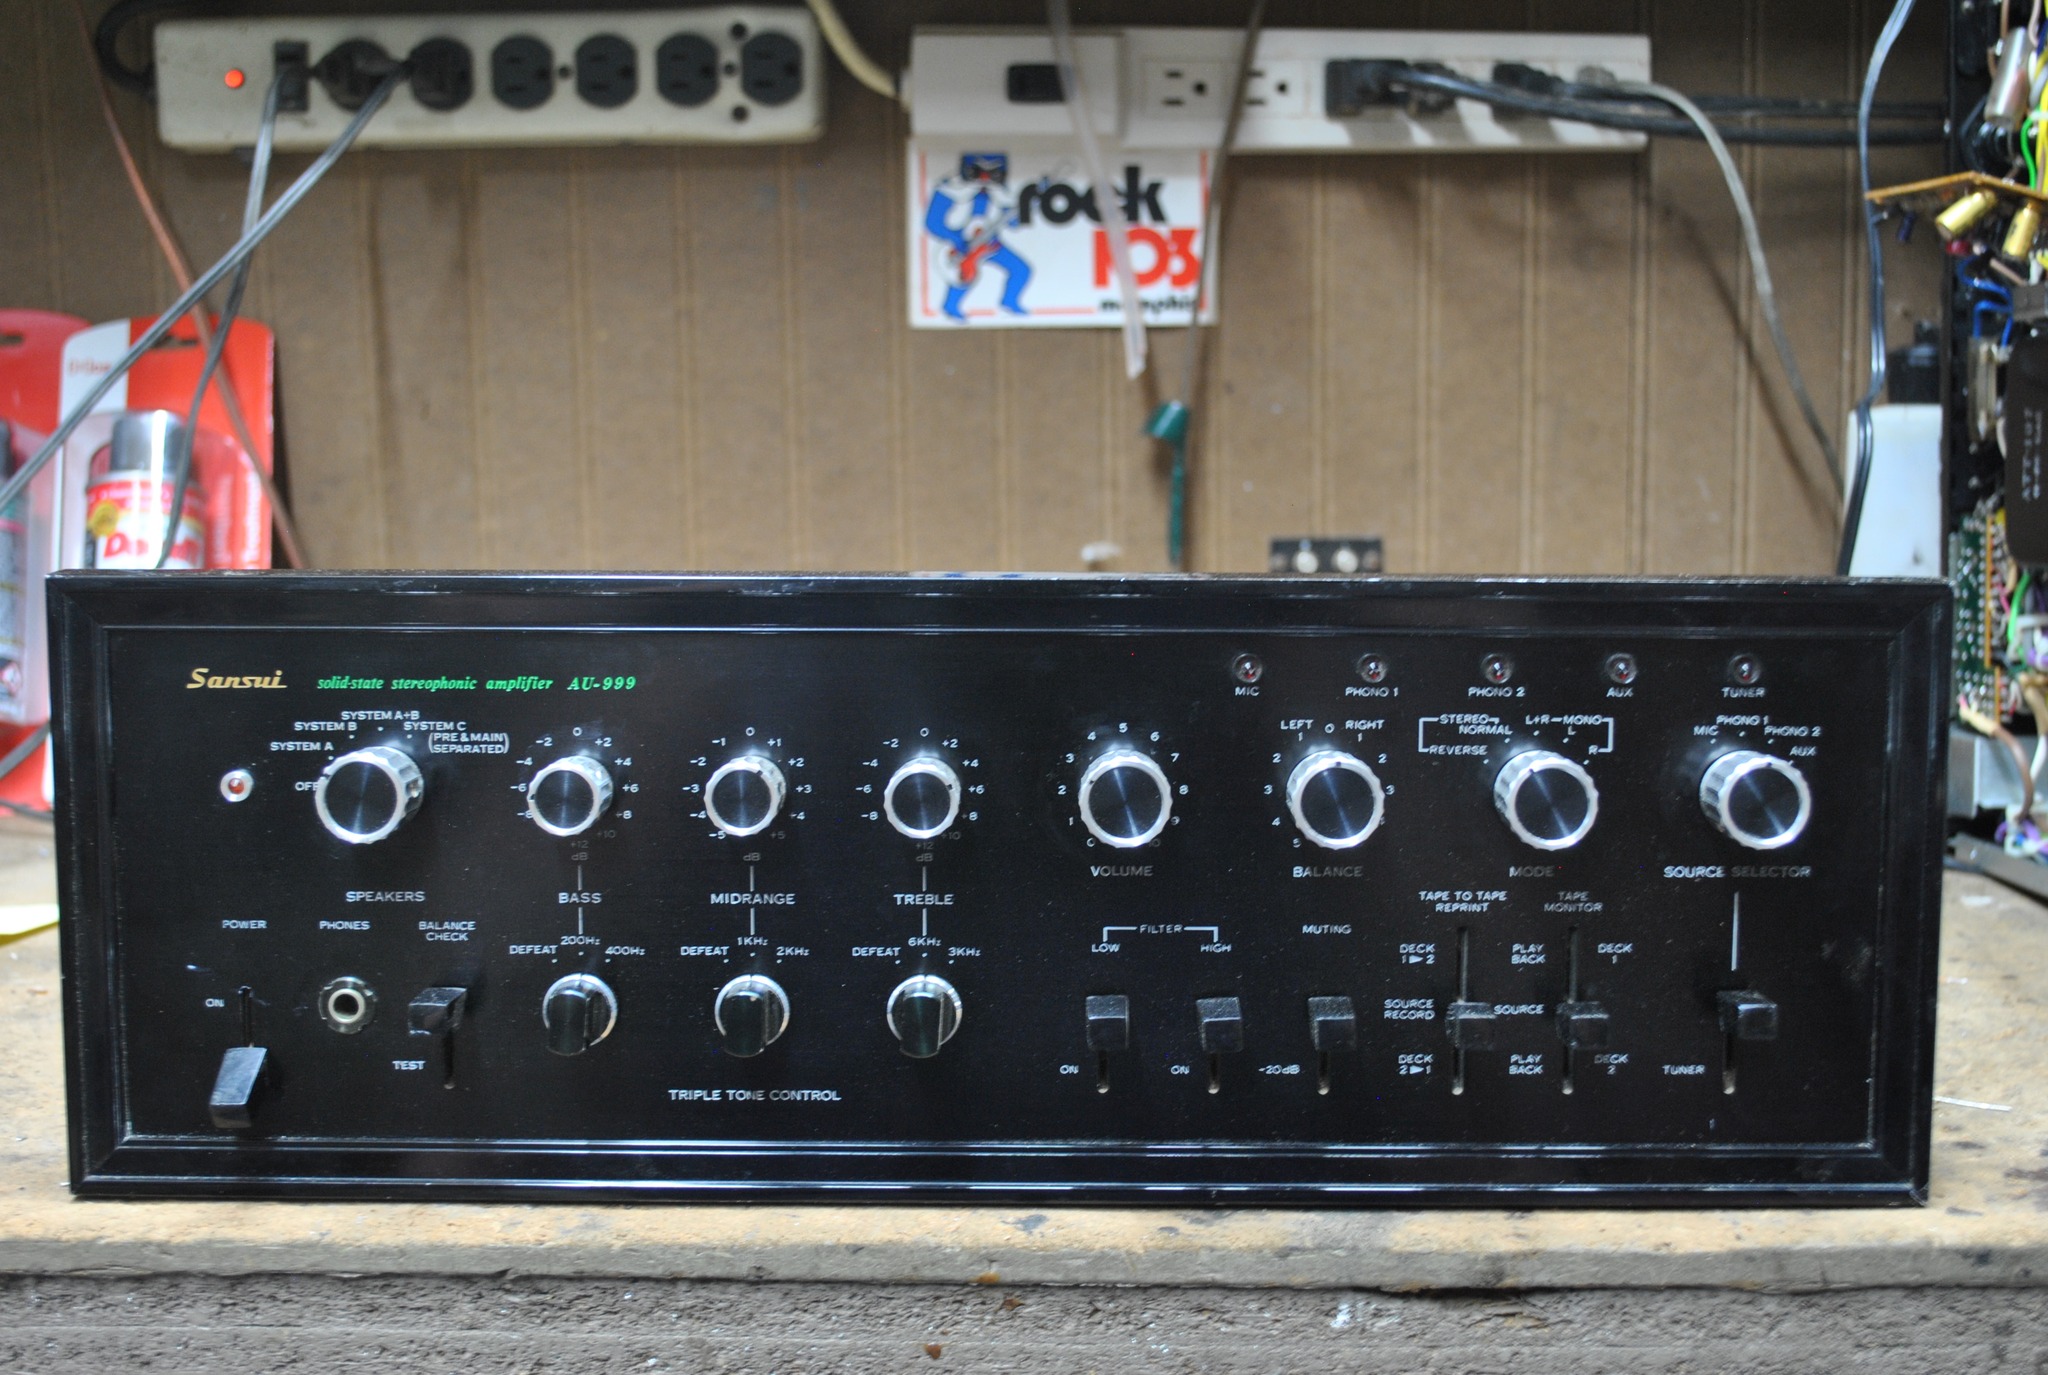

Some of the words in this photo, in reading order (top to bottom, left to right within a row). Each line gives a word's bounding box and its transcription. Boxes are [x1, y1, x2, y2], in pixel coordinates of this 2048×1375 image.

[186, 667, 287, 689] Sansui
[317, 677, 384, 690] solid-state
[390, 677, 477, 692] stereophonic
[485, 676, 553, 692] amplifier
[567, 677, 636, 691] AU-999
[1235, 687, 1260, 697] MIC
[1345, 687, 1389, 697] PHONO
[1393, 687, 1399, 697] 1
[1468, 687, 1512, 697] PHONO
[1516, 687, 1526, 697] 2
[1606, 687, 1633, 698] AUX
[1721, 687, 1765, 698] TUNER
[341, 711, 392, 720] SYSTEM
[393, 711, 420, 720] A+B
[1439, 714, 1489, 724] STEREO
[1563, 714, 1601, 725] MONO
[1716, 715, 1760, 725] PHONO
[1763, 715, 1769, 725] 1
[294, 722, 346, 731] SYSTEM
[349, 722, 358, 731] B
[403, 722, 453, 731] SYSTEM
[456, 722, 466, 731] C
[1118, 723, 1128, 733] 5
[1280, 720, 1314, 730] LEFT
[1345, 720, 1385, 730] RIGHT
[1458, 725, 1513, 735] NORMAL
[1567, 726, 1576, 735] L
[1693, 725, 1719, 736] MIC
[1764, 726, 1808, 736] PHONO
[1811, 726, 1821, 737] 2
[535, 737, 553, 746] -2
[1087, 732, 1097, 741] 4
[1150, 732, 1160, 742] 6
[1298, 732, 1303, 741] 1
[1357, 733, 1363, 742] 1
[270, 742, 321, 751] SYSTEM
[324, 742, 334, 751] A
[595, 737, 612, 747] +2
[712, 738, 726, 746] -1
[767, 738, 782, 747] +1
[883, 739, 899, 748] -2
[942, 739, 958, 748] +2
[1429, 745, 1488, 755] REVERSE
[1589, 746, 1598, 755] R
[1789, 746, 1816, 757] AUX
[516, 757, 533, 766] -4
[615, 757, 632, 766] +4
[690, 757, 707, 766] -2
[788, 757, 805, 767] +2
[1065, 753, 1075, 763] 3
[1171, 753, 1180, 762] 7
[1272, 753, 1282, 763] 2
[1378, 754, 1387, 763] 2
[862, 759, 878, 768] -4
[962, 759, 979, 768] +4
[510, 783, 528, 792] -6
[622, 784, 639, 793] +6
[682, 784, 700, 793] -3
[796, 784, 813, 794] +3
[855, 785, 872, 794] -6
[968, 785, 985, 794] +6
[1057, 785, 1067, 795] 2
[1179, 785, 1189, 795] 8
[1264, 785, 1273, 795] 3
[1385, 785, 1395, 795] 3
[615, 810, 632, 819] +8
[689, 811, 707, 819] -4
[789, 811, 806, 820] +4
[861, 811, 878, 820] -8
[1069, 817, 1074, 826] 1
[1171, 816, 1181, 825] 9
[1272, 817, 1280, 826] 4
[709, 831, 726, 839] -5
[1292, 838, 1301, 848] 5
[571, 852, 589, 861] dB
[743, 852, 761, 861] dB
[916, 853, 933, 862] dB
[1090, 866, 1154, 877] VOLUME
[1293, 866, 1364, 878] BALANCE
[1509, 866, 1554, 877] MODE
[1663, 866, 1724, 878] SOURCE
[1731, 866, 1811, 878] SELECTOR
[346, 891, 425, 902] SPEAKERS
[558, 892, 602, 904] BASS
[710, 893, 796, 905] MIDRANGE
[893, 893, 954, 905] TREBLE
[1419, 891, 1450, 901] TAPE
[1454, 891, 1473, 901] TO
[1476, 891, 1508, 901] TAPE
[1557, 891, 1589, 901] TAPE
[1435, 902, 1490, 913] REPRINT
[1544, 903, 1603, 913] MONITOR
[222, 920, 267, 929] POWER
[319, 921, 370, 930] PHONES
[419, 921, 476, 931] BALANCE
[1140, 924, 1184, 934] FILTER
[1302, 925, 1352, 935] MUTING
[426, 932, 468, 941] CHECK
[560, 936, 600, 945] 200Hz
[737, 936, 768, 946] 1KHz
[908, 937, 942, 946] 6KHz
[509, 945, 559, 955] DEFEAT
[605, 947, 645, 956] 400Hz
[680, 946, 729, 956] DEFEAT
[776, 947, 810, 956] 2KHz
[852, 947, 901, 957] DEFEAT
[948, 947, 981, 956] 3KHz
[1091, 944, 1120, 953] LOW
[1201, 944, 1232, 953] HIGH
[1400, 944, 1436, 954] DECK
[1512, 944, 1545, 954] PLAY
[1597, 943, 1633, 954] DECK
[1426, 954, 1435, 964] 2
[1511, 954, 1546, 965] BACK
[1612, 955, 1618, 964] 1
[205, 999, 225, 1008] ON
[1384, 999, 1434, 1009] SOURCE
[1493, 1004, 1545, 1014] SOURCE
[1384, 1010, 1435, 1020] RECORD
[1398, 1054, 1434, 1064] DECK
[1510, 1054, 1543, 1064] PLAY
[1594, 1054, 1629, 1064] DECK
[392, 1061, 426, 1070] TEST
[1059, 1065, 1079, 1075] ON
[1170, 1065, 1190, 1075] ON
[1258, 1065, 1300, 1075] -20dB
[1399, 1065, 1408, 1075] 2
[1509, 1065, 1543, 1075] BACK
[1607, 1065, 1616, 1075] 2
[1662, 1065, 1706, 1075] TUNER
[668, 1089, 722, 1100] TRIPLE
[725, 1089, 765, 1100] TONE
[769, 1089, 842, 1101] CONTROL
